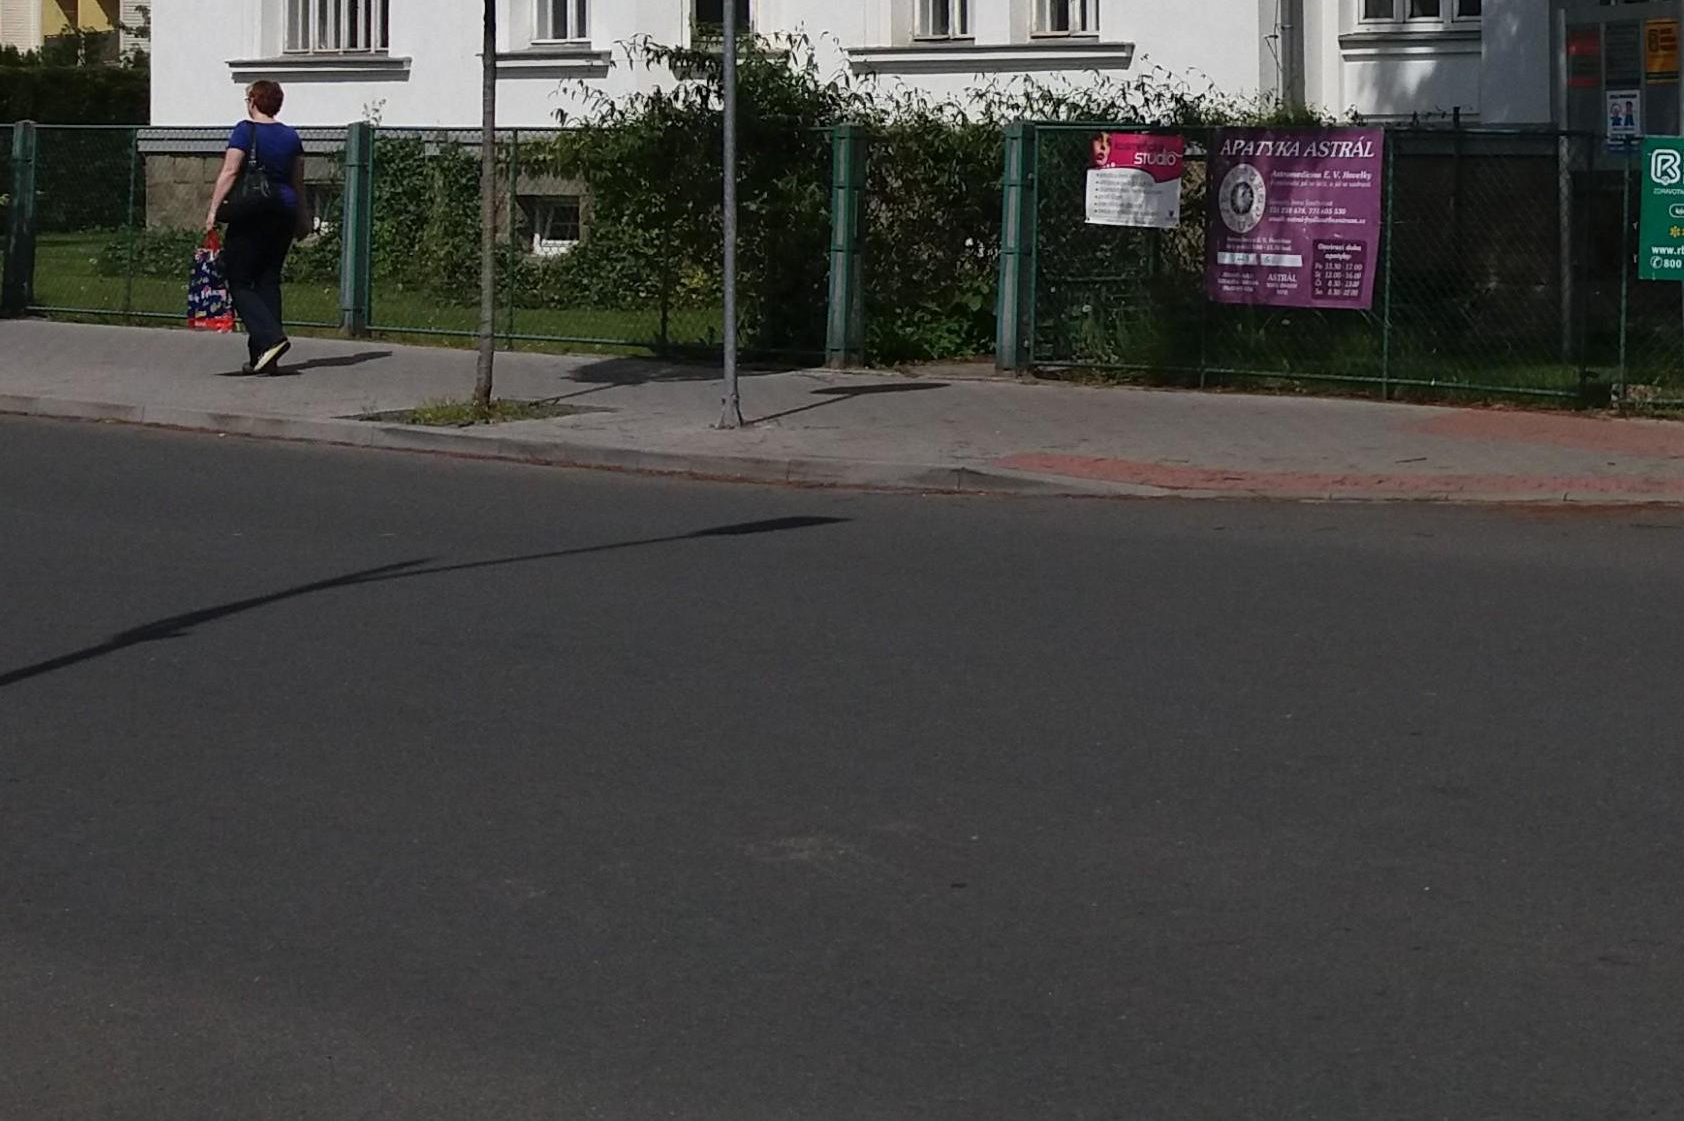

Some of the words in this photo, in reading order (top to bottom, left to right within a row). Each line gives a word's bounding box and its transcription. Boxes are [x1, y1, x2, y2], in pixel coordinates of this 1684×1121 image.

[1220, 139, 1300, 156] APATYKA
[1303, 136, 1374, 157] ASTRÁL
[1663, 259, 1682, 268] 800
